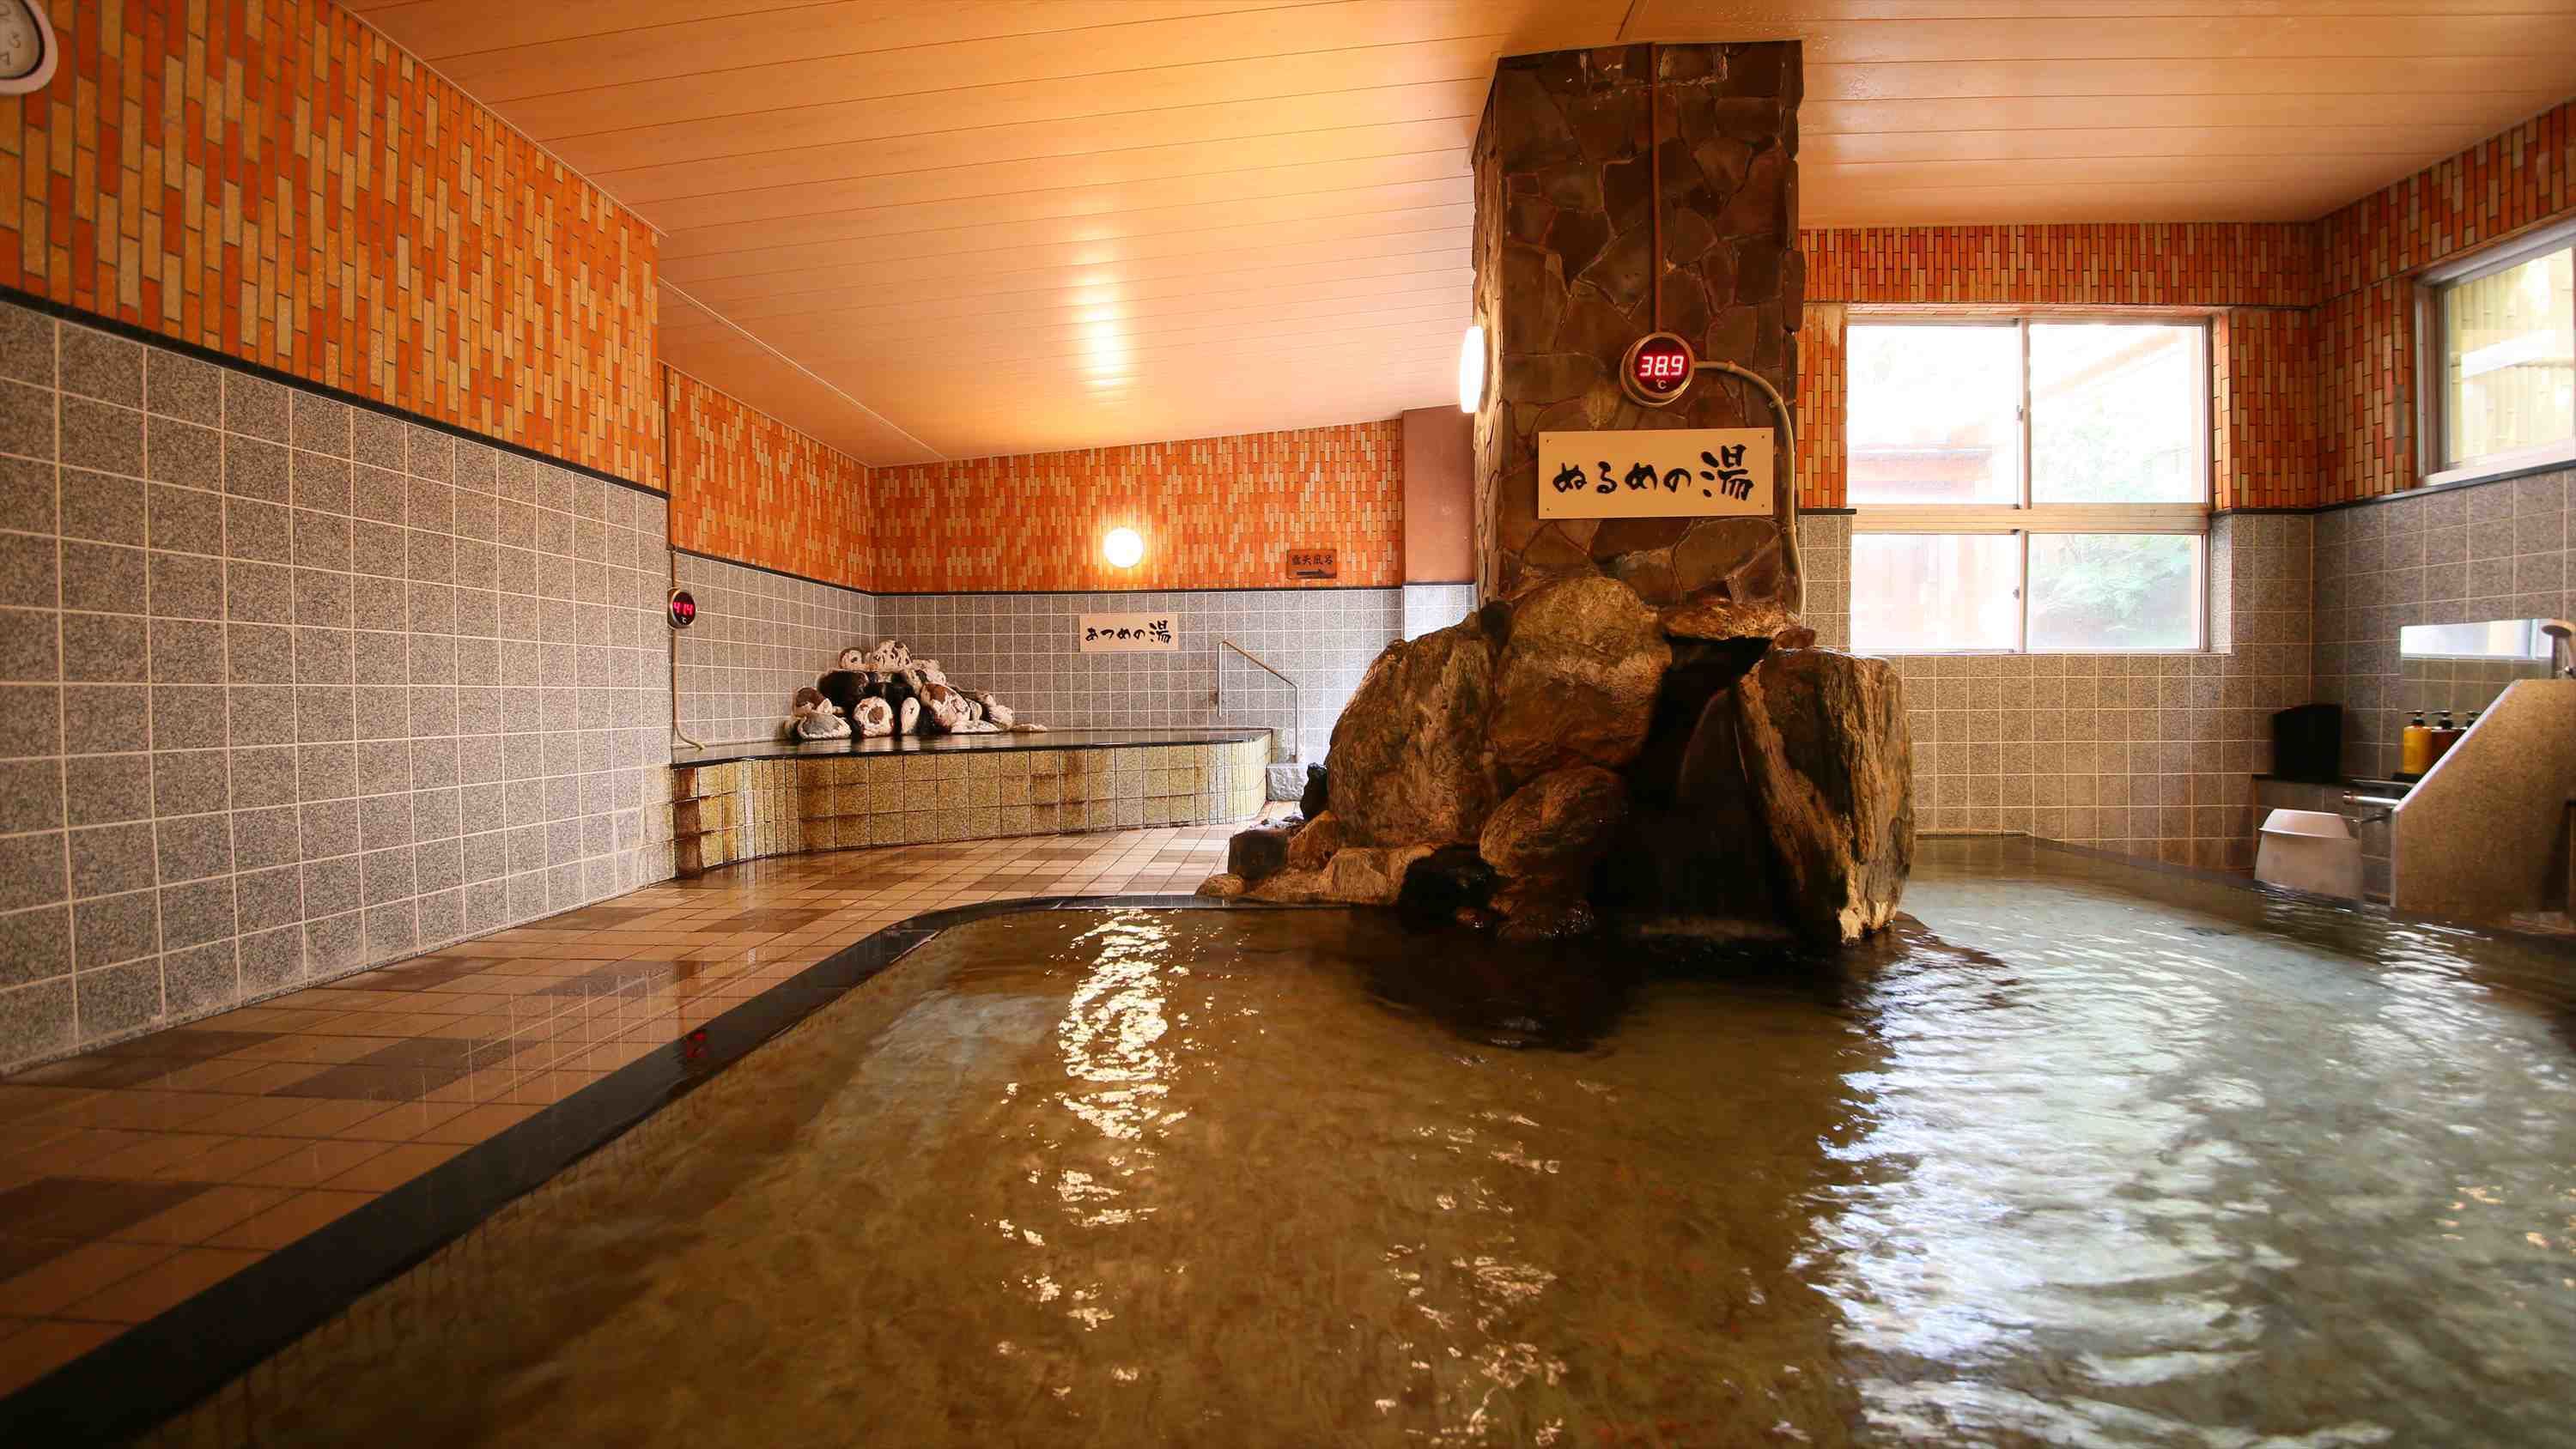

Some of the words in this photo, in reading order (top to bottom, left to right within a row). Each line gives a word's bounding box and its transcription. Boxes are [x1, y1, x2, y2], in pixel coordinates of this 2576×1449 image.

[1639, 355, 1685, 377] 38.9
[1552, 444, 1754, 501] ぬるめの湯
[1085, 620, 1171, 644] あつめの湯
